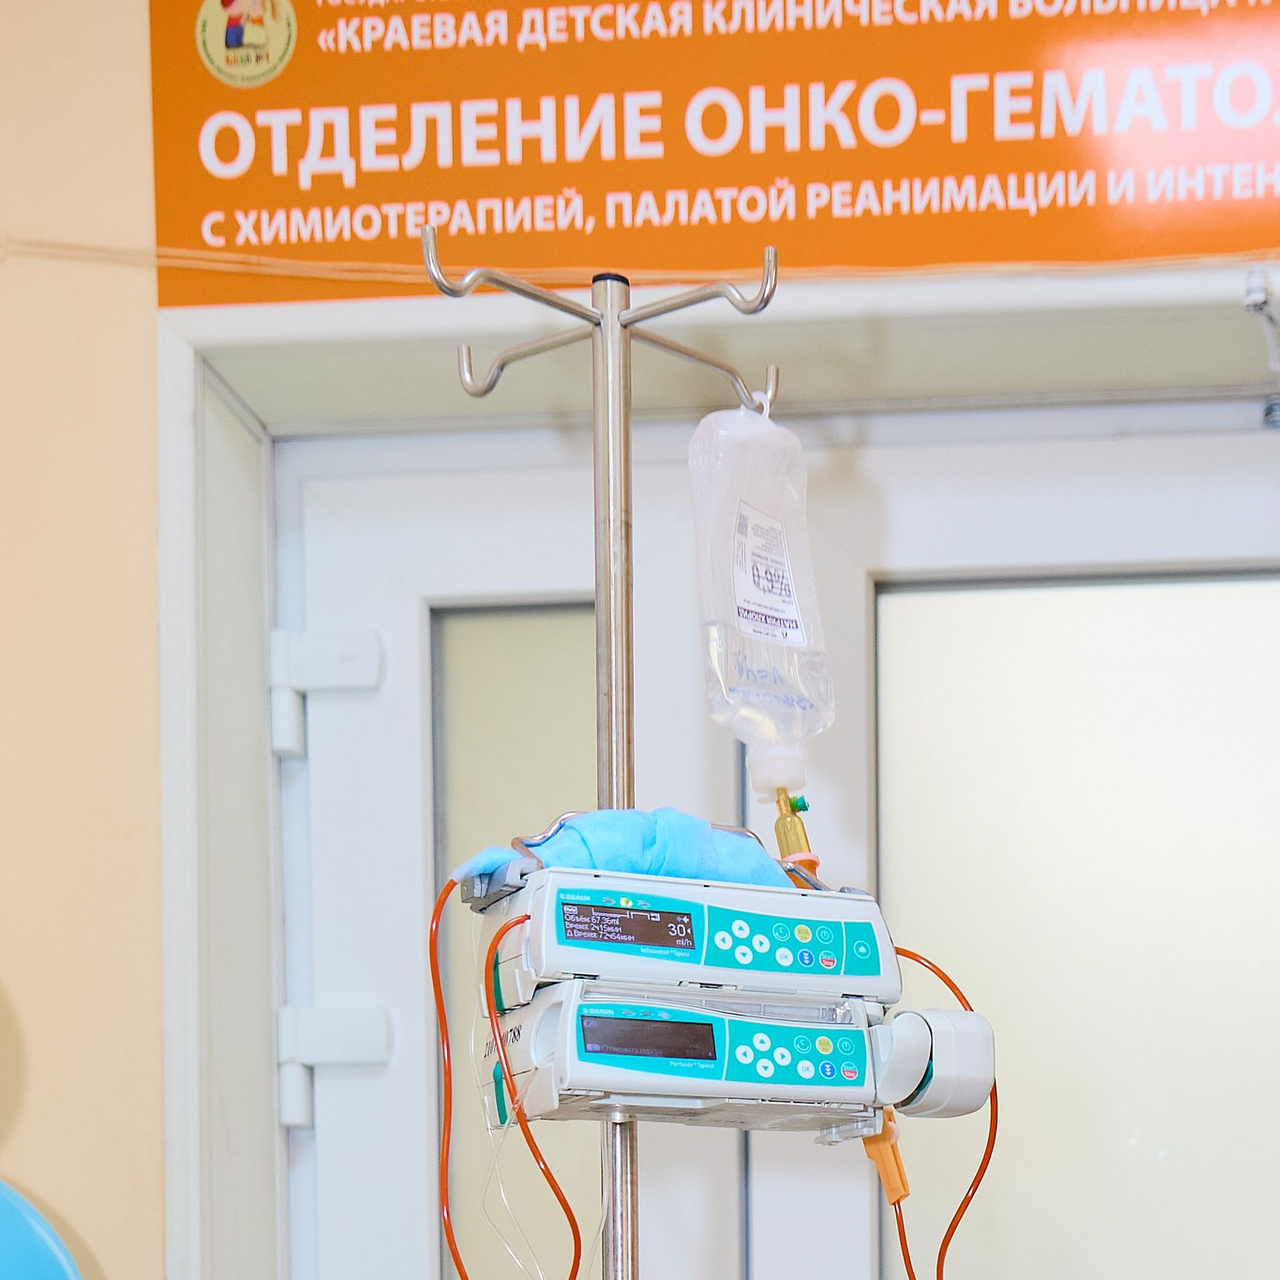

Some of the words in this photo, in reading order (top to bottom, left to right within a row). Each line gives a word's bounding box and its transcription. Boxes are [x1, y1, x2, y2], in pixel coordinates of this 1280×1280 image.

[317, 9, 508, 53] «КРАЕВАЯ
[517, 0, 693, 53] ДЕТСКАЯ
[198, 90, 664, 190] ОТДЕЛЕНИЕ
[200, 210, 227, 248] С
[234, 186, 595, 246] ХИМИОТЕРАПИЕЙ,
[605, 177, 797, 229] ПАЛАТОЙ
[806, 169, 1096, 219] РЕАНИМАЦИИ
[1107, 167, 1136, 206] И
[668, 923, 686, 937] 30
